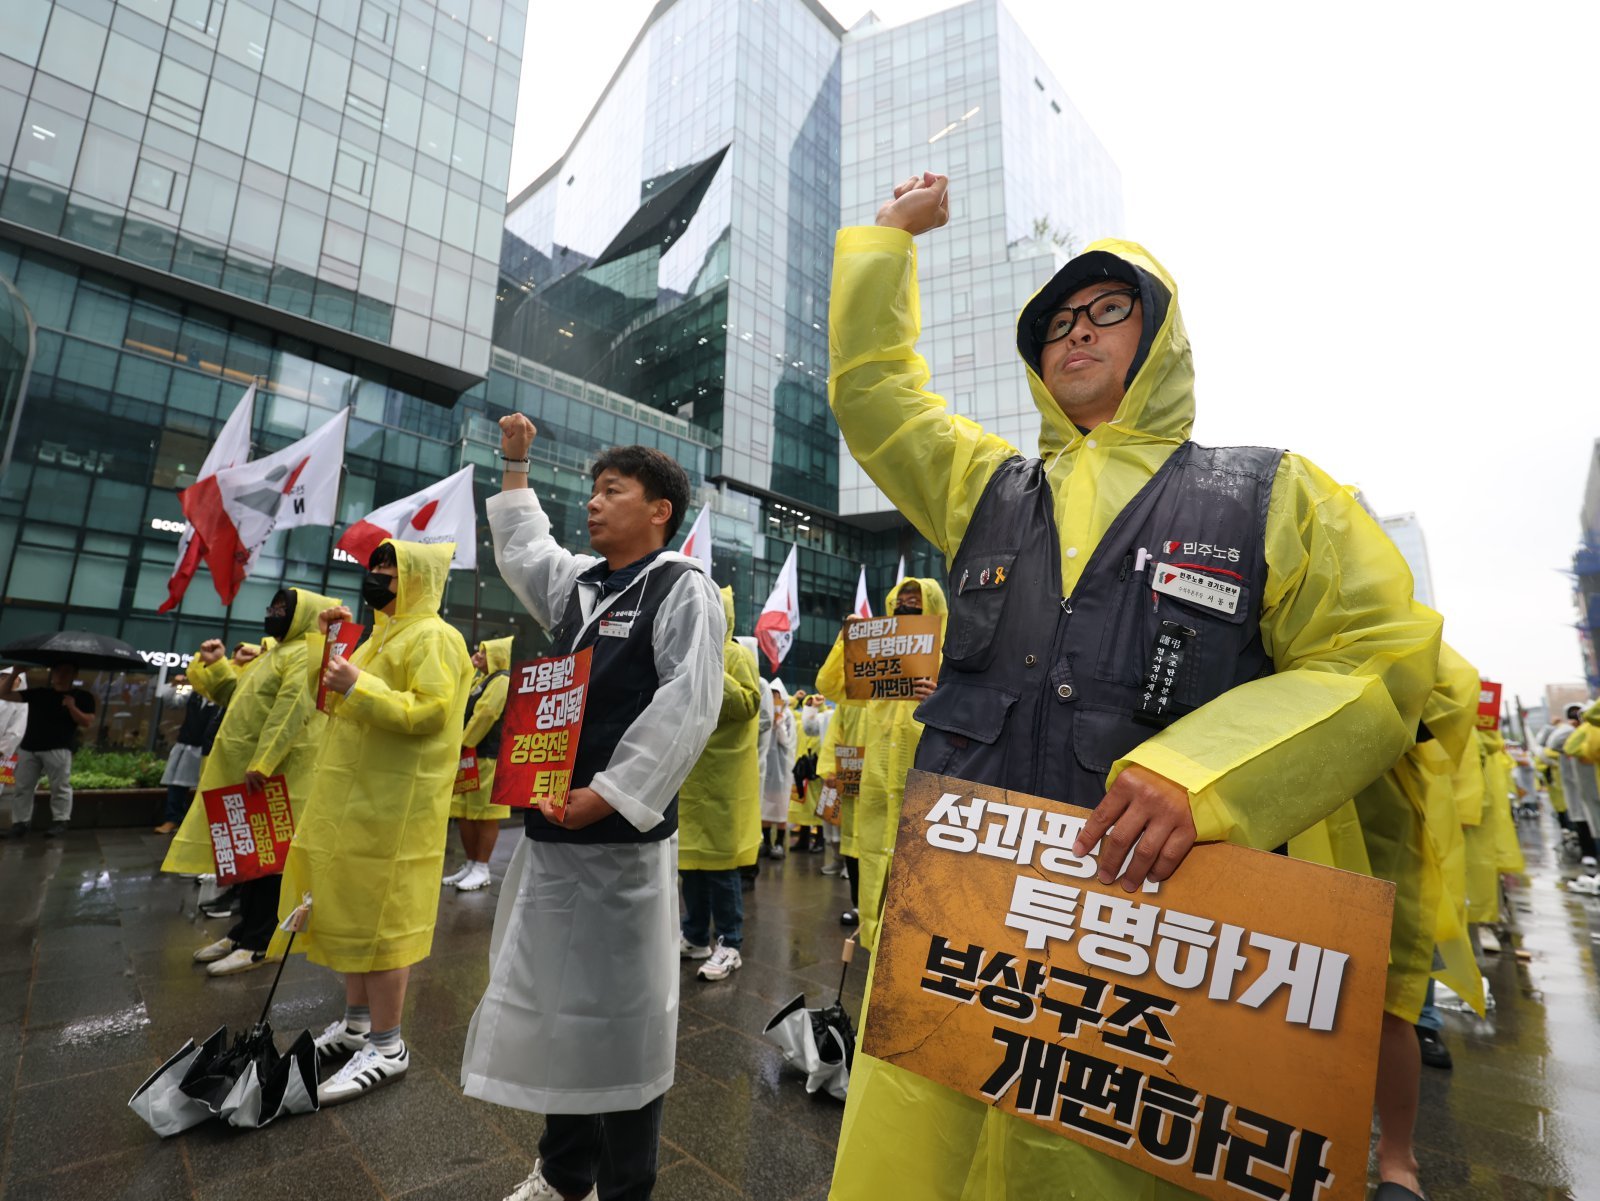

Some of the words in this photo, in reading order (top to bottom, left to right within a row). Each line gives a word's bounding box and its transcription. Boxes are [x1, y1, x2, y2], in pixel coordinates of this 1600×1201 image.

[1183, 541, 1240, 562] 민주노총
[1180, 572, 1204, 585] 민주노총
[1207, 581, 1237, 595] 경기도본부
[848, 617, 897, 640] 성과평가
[866, 634, 934, 658] 투명하게
[518, 655, 575, 694] 고용불안
[854, 658, 902, 678] 보상구조
[536, 684, 585, 730] 성과독점
[510, 730, 569, 764] 경영진은
[222, 793, 255, 855] 성과독점
[264, 782, 293, 842] 퇴진하라
[210, 823, 236, 877] 고용불안
[250, 813, 275, 866] 경영진은
[924, 793, 1160, 892] 성과평
[1005, 875, 1350, 1031] 투명하게
[919, 935, 1180, 1064] 보상구조
[979, 1025, 1336, 1201] 개편하라
